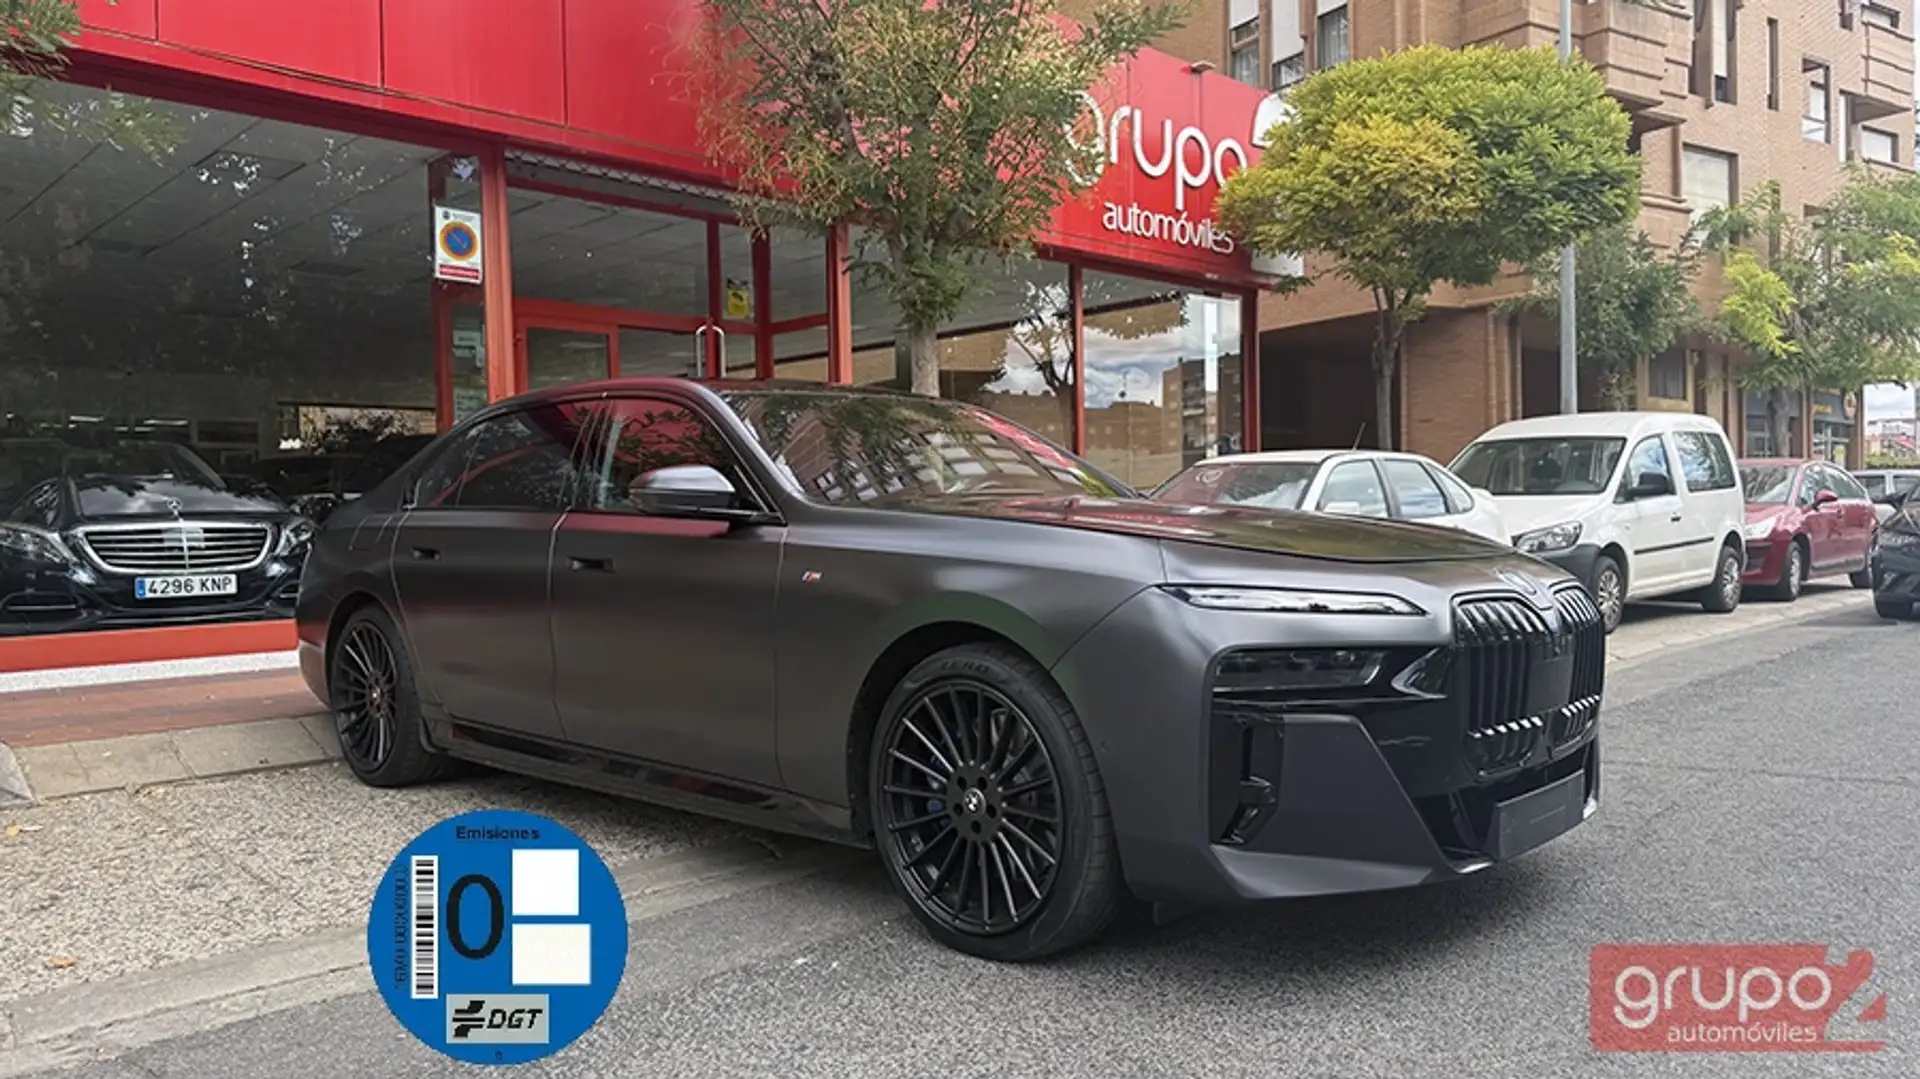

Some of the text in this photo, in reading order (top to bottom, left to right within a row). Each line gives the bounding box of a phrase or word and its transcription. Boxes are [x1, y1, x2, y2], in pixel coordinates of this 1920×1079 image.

[1102, 202, 1235, 254] automóviles
[148, 576, 232, 594] 4296 KNP
